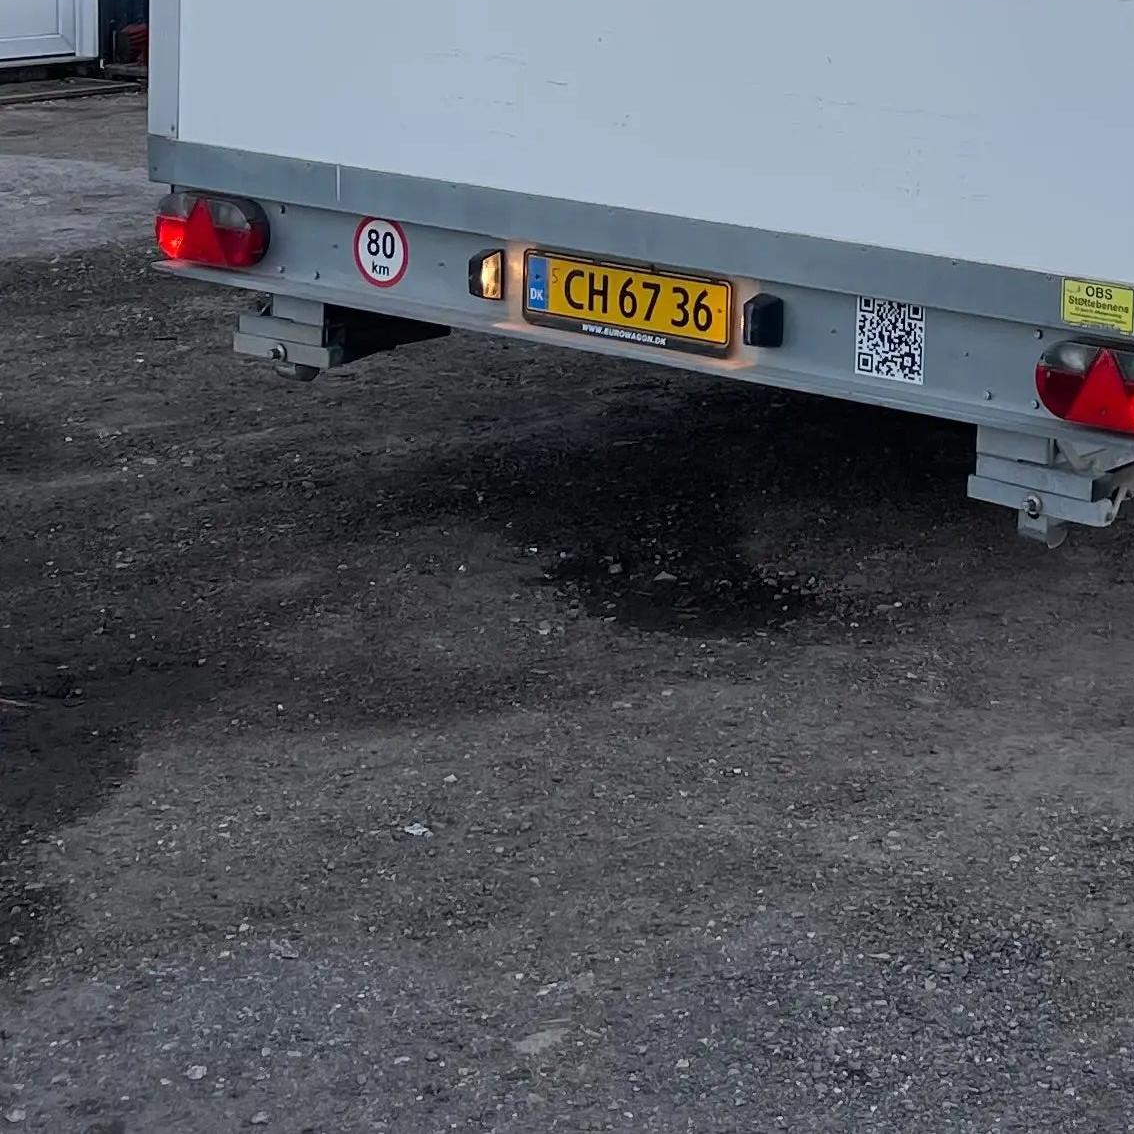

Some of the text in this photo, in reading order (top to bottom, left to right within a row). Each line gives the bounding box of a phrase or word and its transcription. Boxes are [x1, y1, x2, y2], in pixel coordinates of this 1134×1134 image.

[367, 228, 396, 259] 80
[371, 259, 390, 277] km
[530, 287, 544, 302] DK
[564, 269, 609, 314] CH
[618, 277, 661, 321] 67
[670, 286, 713, 332] 36
[1085, 285, 1113, 300] OBS
